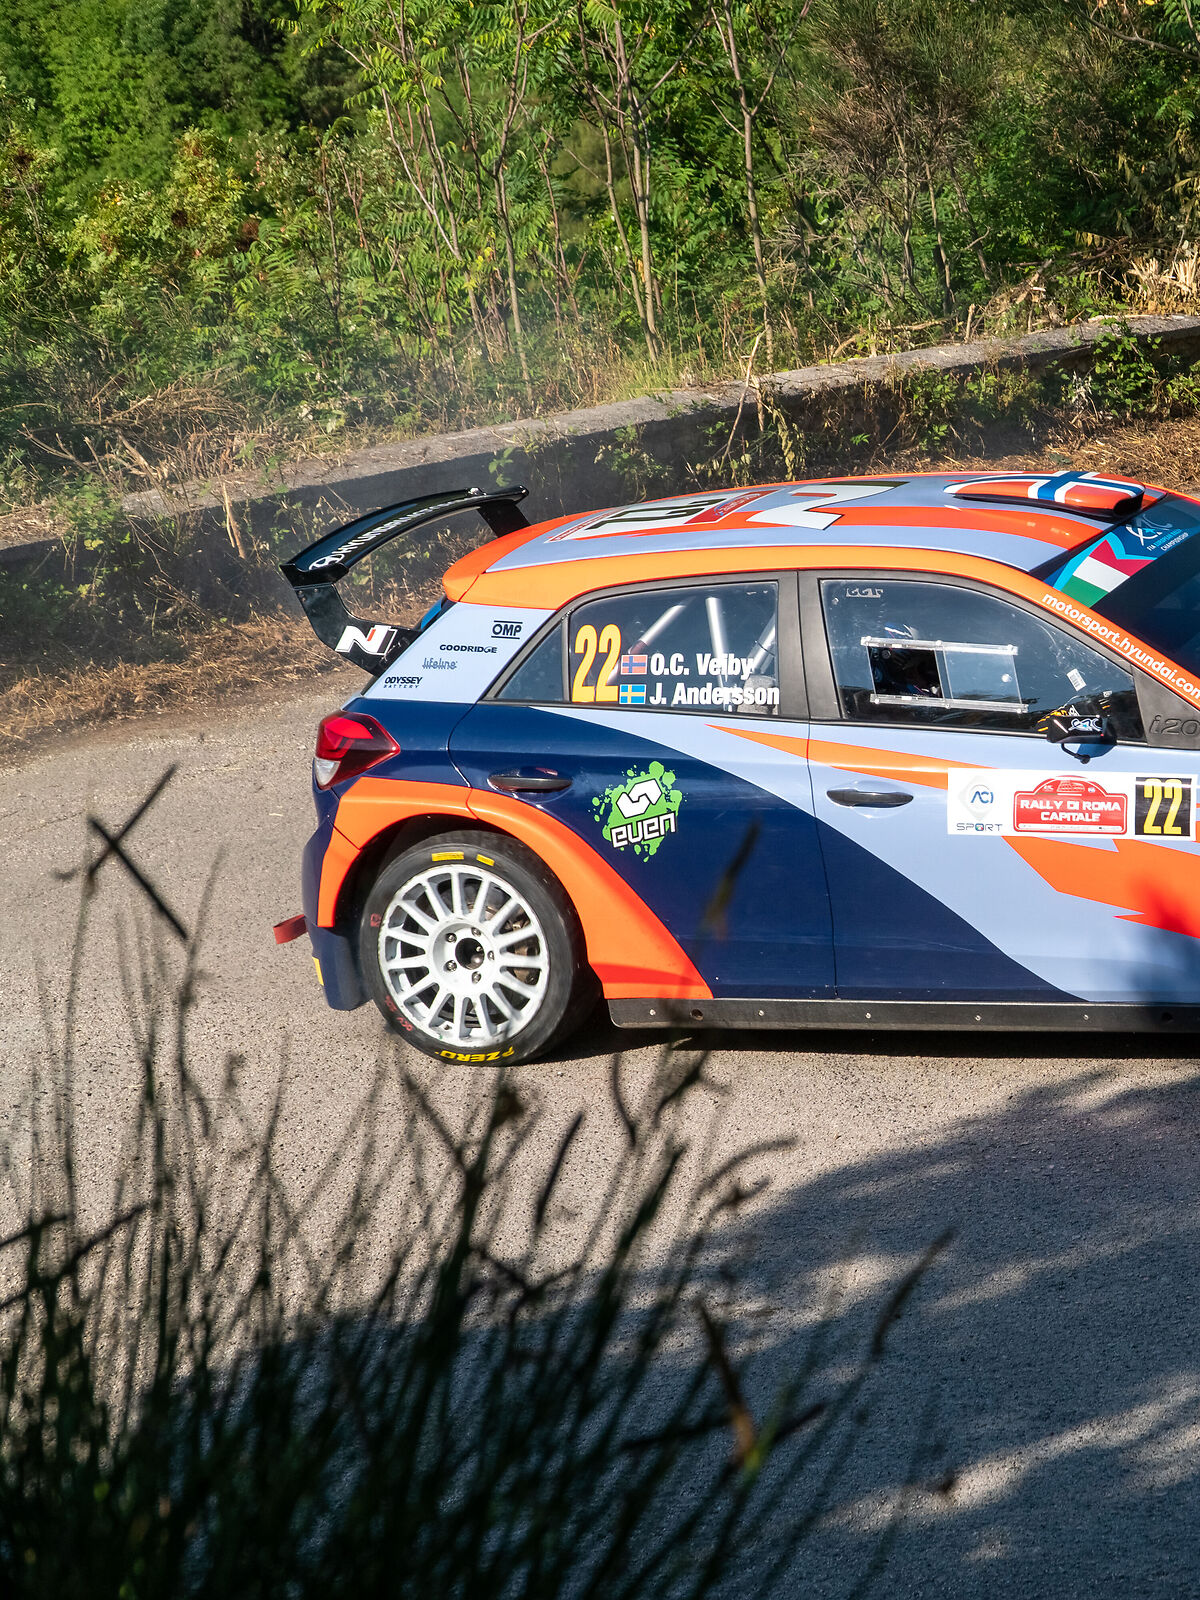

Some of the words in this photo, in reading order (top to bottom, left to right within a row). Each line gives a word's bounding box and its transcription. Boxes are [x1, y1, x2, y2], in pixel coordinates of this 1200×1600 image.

[492, 622, 522, 638] OMP
[439, 644, 498, 654] GOODRIDGE
[572, 623, 622, 703] 22
[650, 652, 690, 676] O.C.
[696, 652, 755, 681] Veiby
[384, 676, 423, 685] ODYSSEY
[650, 682, 667, 705] J.
[672, 682, 780, 706] Andersson
[1149, 714, 1200, 736] i20
[970, 790, 994, 804] ACI
[1020, 799, 1064, 810] RALLY
[1066, 801, 1080, 811] DI
[1082, 801, 1121, 812] ROMA
[1143, 777, 1183, 835] 22
[1040, 811, 1101, 822] CAPITALE
[956, 822, 1003, 832] SPORT
